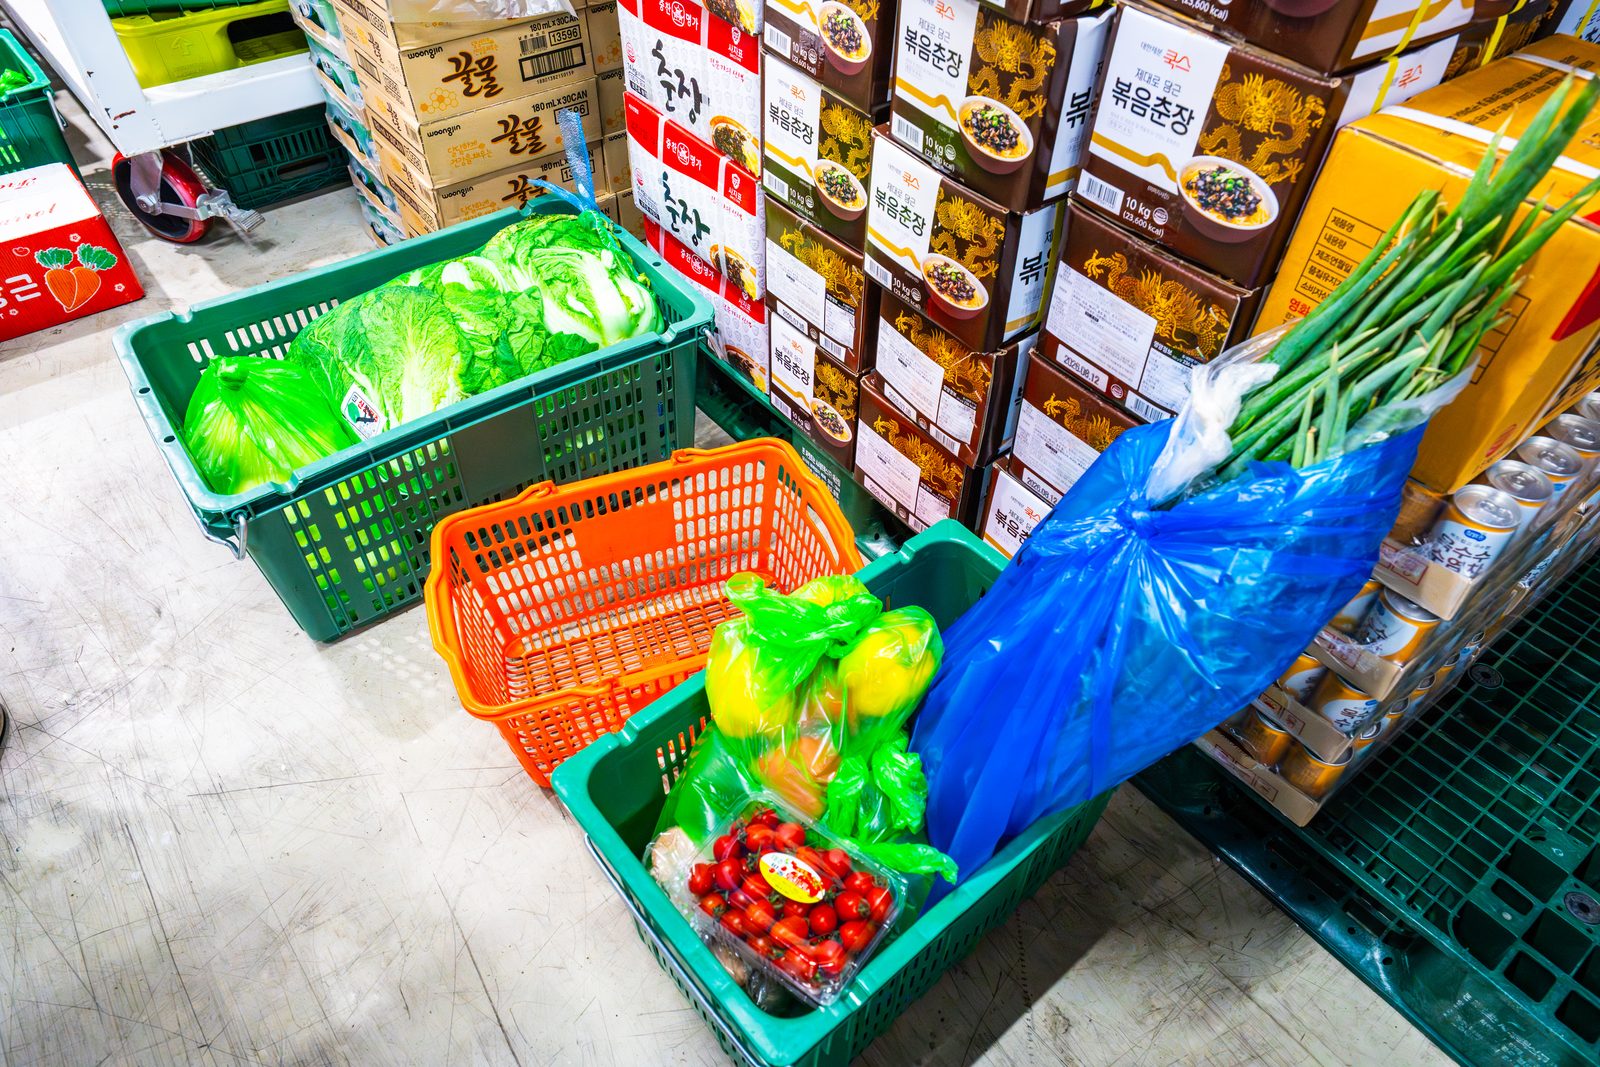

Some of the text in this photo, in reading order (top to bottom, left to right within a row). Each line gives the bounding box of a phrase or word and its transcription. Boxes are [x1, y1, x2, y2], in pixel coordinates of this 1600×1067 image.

[1210, 4, 1229, 22] kcal)
[552, 26, 579, 43] 13596
[408, 46, 443, 60] woongjin
[792, 41, 808, 59] 10 kg
[904, 25, 963, 79] 볶음춘장
[1163, 48, 1191, 72] 쿡스
[441, 51, 504, 98] 꿀물
[651, 38, 711, 125] 춘장
[1135, 67, 1182, 97] 제대로 담근
[1112, 76, 1195, 135] 볶음춘장
[427, 124, 461, 138] woongjin
[491, 114, 548, 155] 꿀물
[768, 102, 814, 146] 볶음춘장
[925, 134, 944, 156] 10 kg
[442, 185, 474, 199] woongjin
[902, 170, 920, 190] 쿡스
[789, 187, 805, 205] 10 kg
[1125, 196, 1137, 211] 10
[1138, 202, 1151, 220] kg
[662, 171, 711, 246] 춘장
[875, 186, 926, 237] 볶음춘장
[1122, 210, 1147, 229] (23,600
[1148, 222, 1164, 238] kcal)
[1331, 216, 1355, 233] 제품명
[1323, 233, 1347, 250] 내용량
[893, 277, 911, 297] 10 kg
[774, 347, 811, 386] 볶음춘장
[1063, 354, 1100, 386] 2026.08.12
